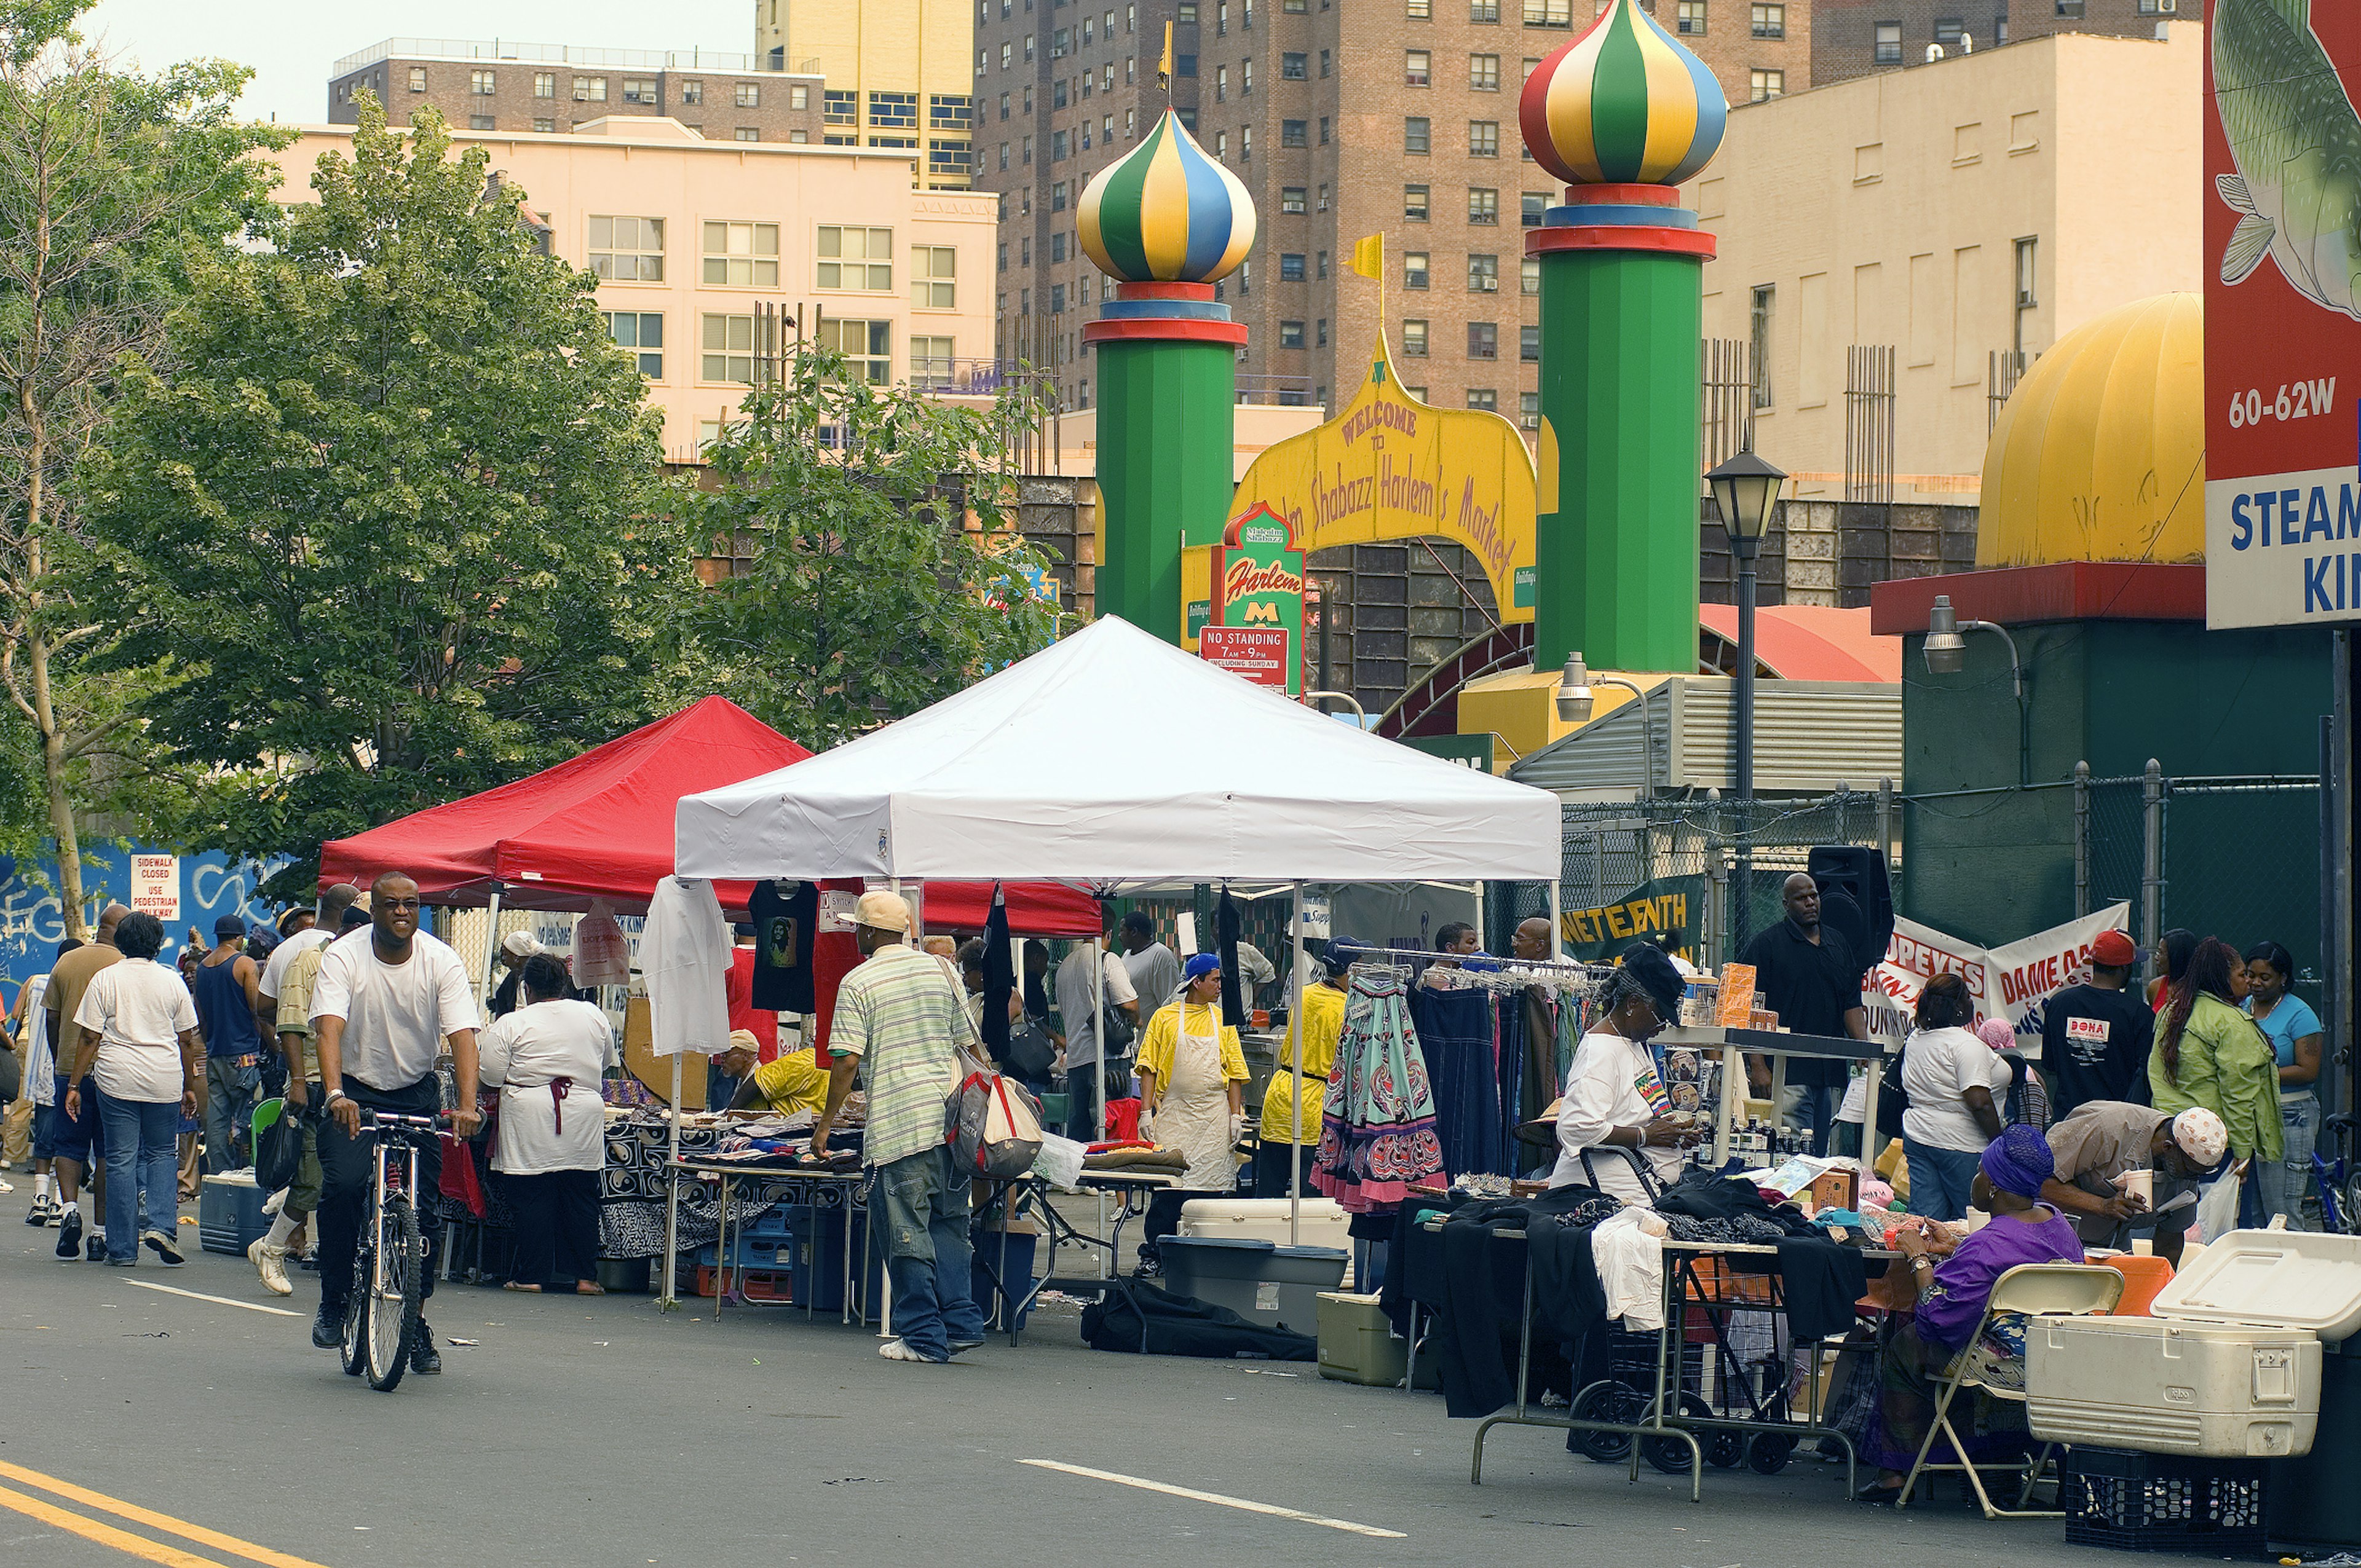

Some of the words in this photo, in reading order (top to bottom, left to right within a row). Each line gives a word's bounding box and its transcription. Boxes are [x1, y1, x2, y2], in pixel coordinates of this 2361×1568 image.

[2228, 376, 2336, 429] 60-62W
[1341, 400, 1417, 447] WELCOME
[1370, 434, 1385, 451] TO
[1310, 461, 1374, 532] Shabazz
[1380, 453, 1449, 522] Harlem's
[1457, 473, 1517, 581] Market
[1227, 559, 1302, 604] Harlem
[1207, 632, 1222, 644] NO
[1227, 632, 1281, 645] STANDING
[138, 858, 173, 867] SIDEWALK
[142, 870, 169, 878] CLOSED
[149, 886, 163, 895] USE
[133, 897, 178, 907] PEDESTRIAN
